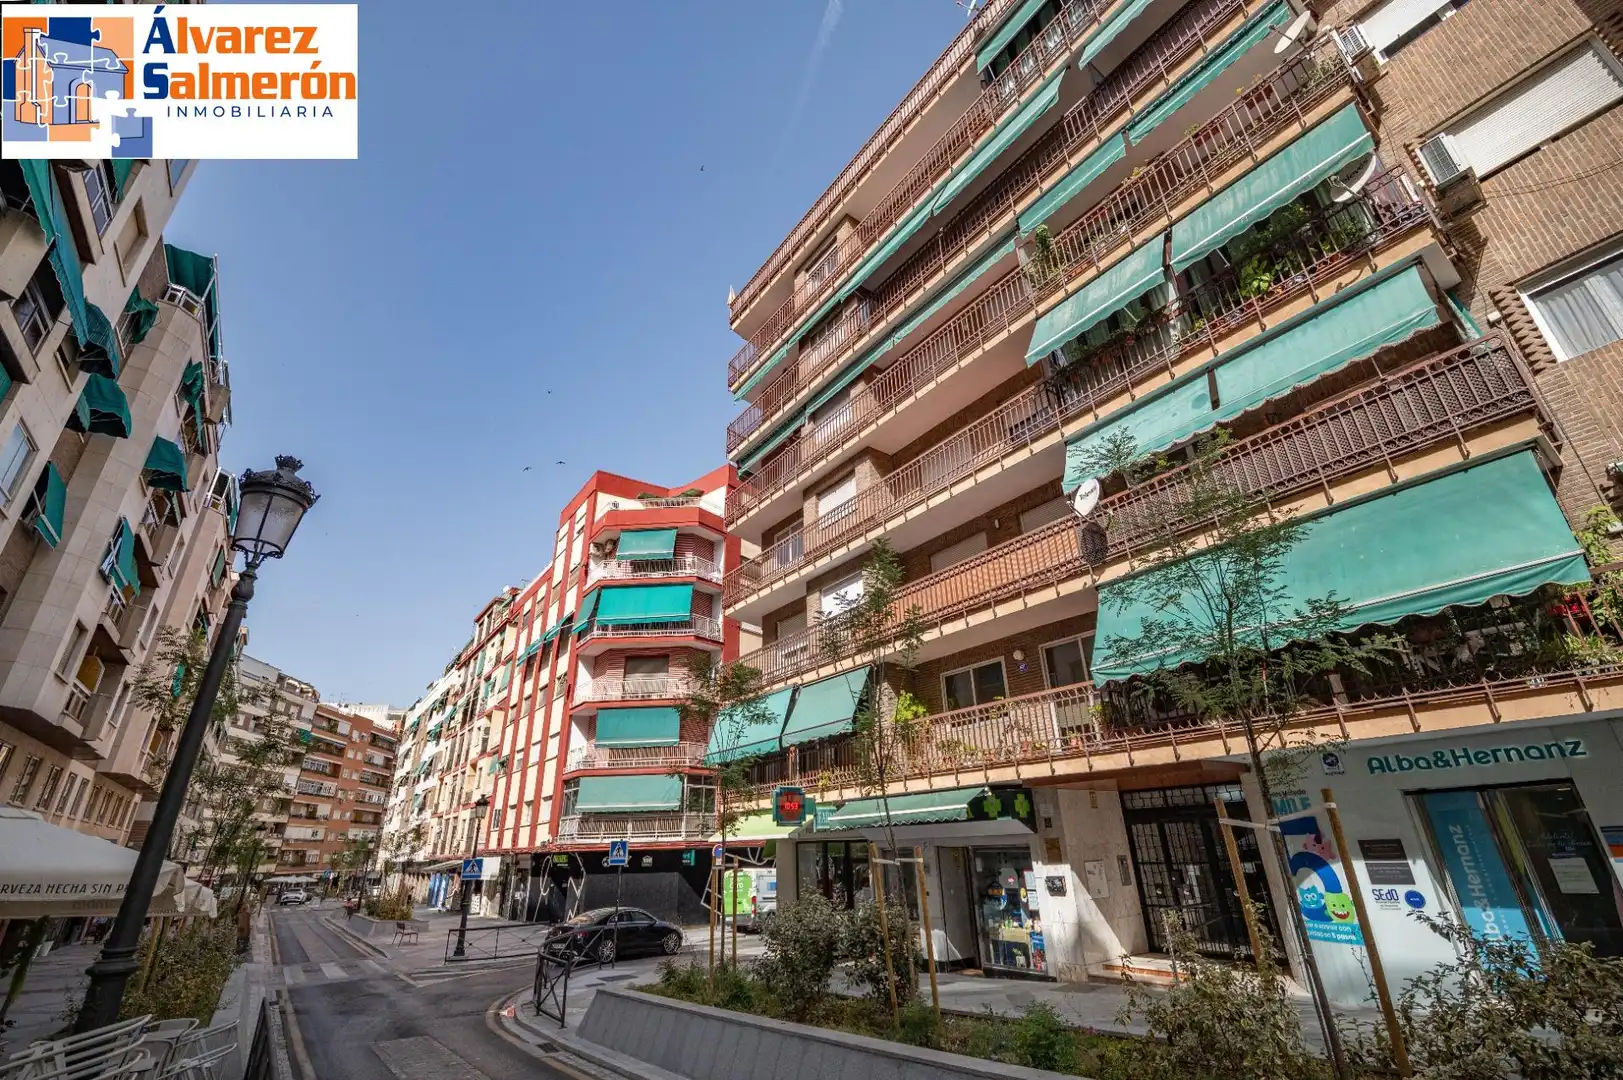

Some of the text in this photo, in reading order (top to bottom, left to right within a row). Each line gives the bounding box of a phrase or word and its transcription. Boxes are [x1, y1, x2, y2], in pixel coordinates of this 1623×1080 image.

[1367, 740, 1587, 775] Alba&Hernanz
[0, 883, 42, 894] RVEZA
[45, 883, 88, 894] HECHA
[91, 883, 112, 894] SIN
[1449, 824, 1501, 942] lba&Hernanz
